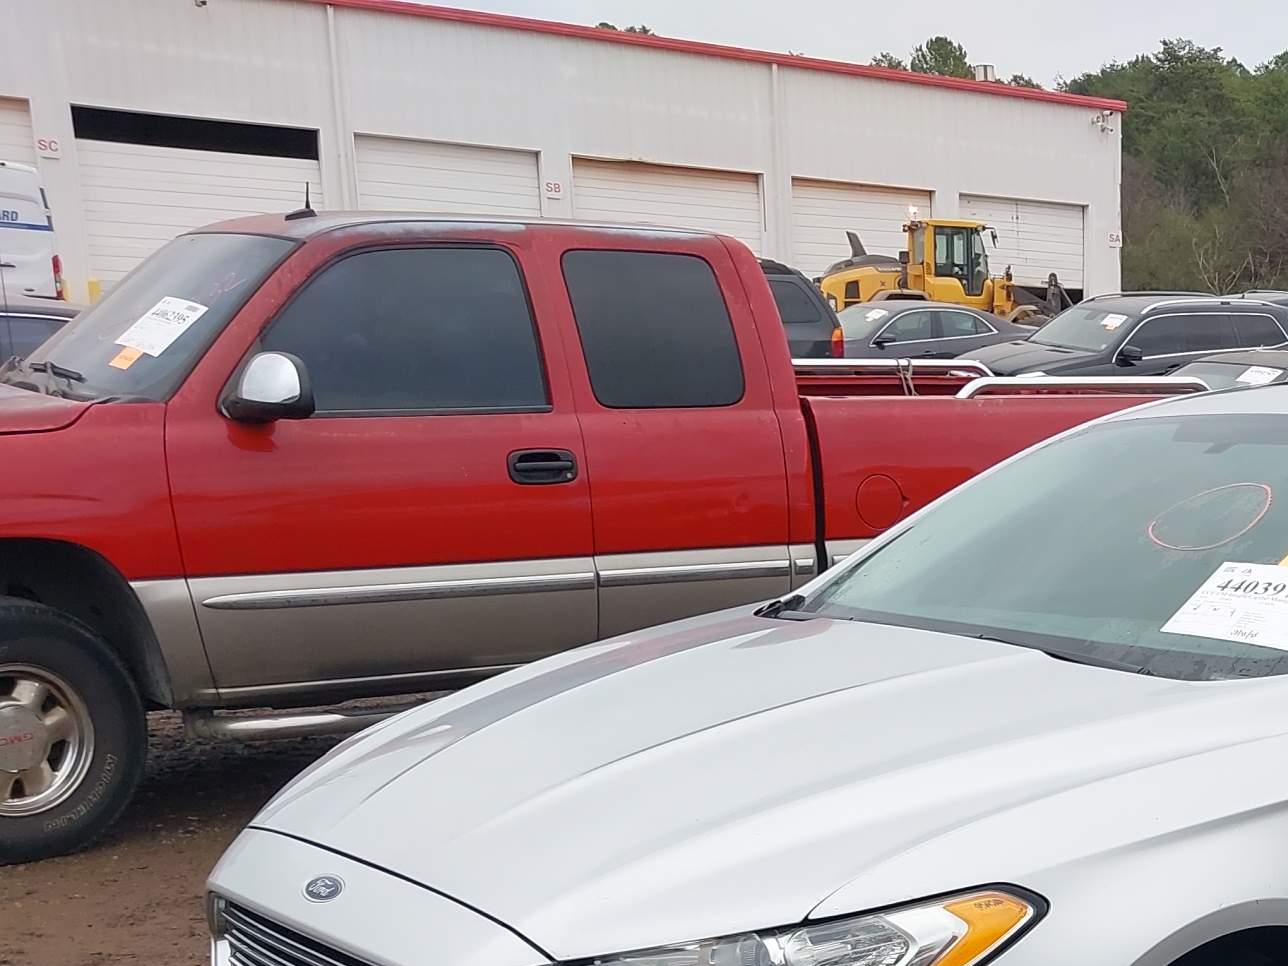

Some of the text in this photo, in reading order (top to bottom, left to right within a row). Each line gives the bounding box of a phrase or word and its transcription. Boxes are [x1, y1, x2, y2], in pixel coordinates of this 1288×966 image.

[38, 139, 59, 152] SC
[545, 182, 561, 193] SB
[0, 209, 19, 222] RD
